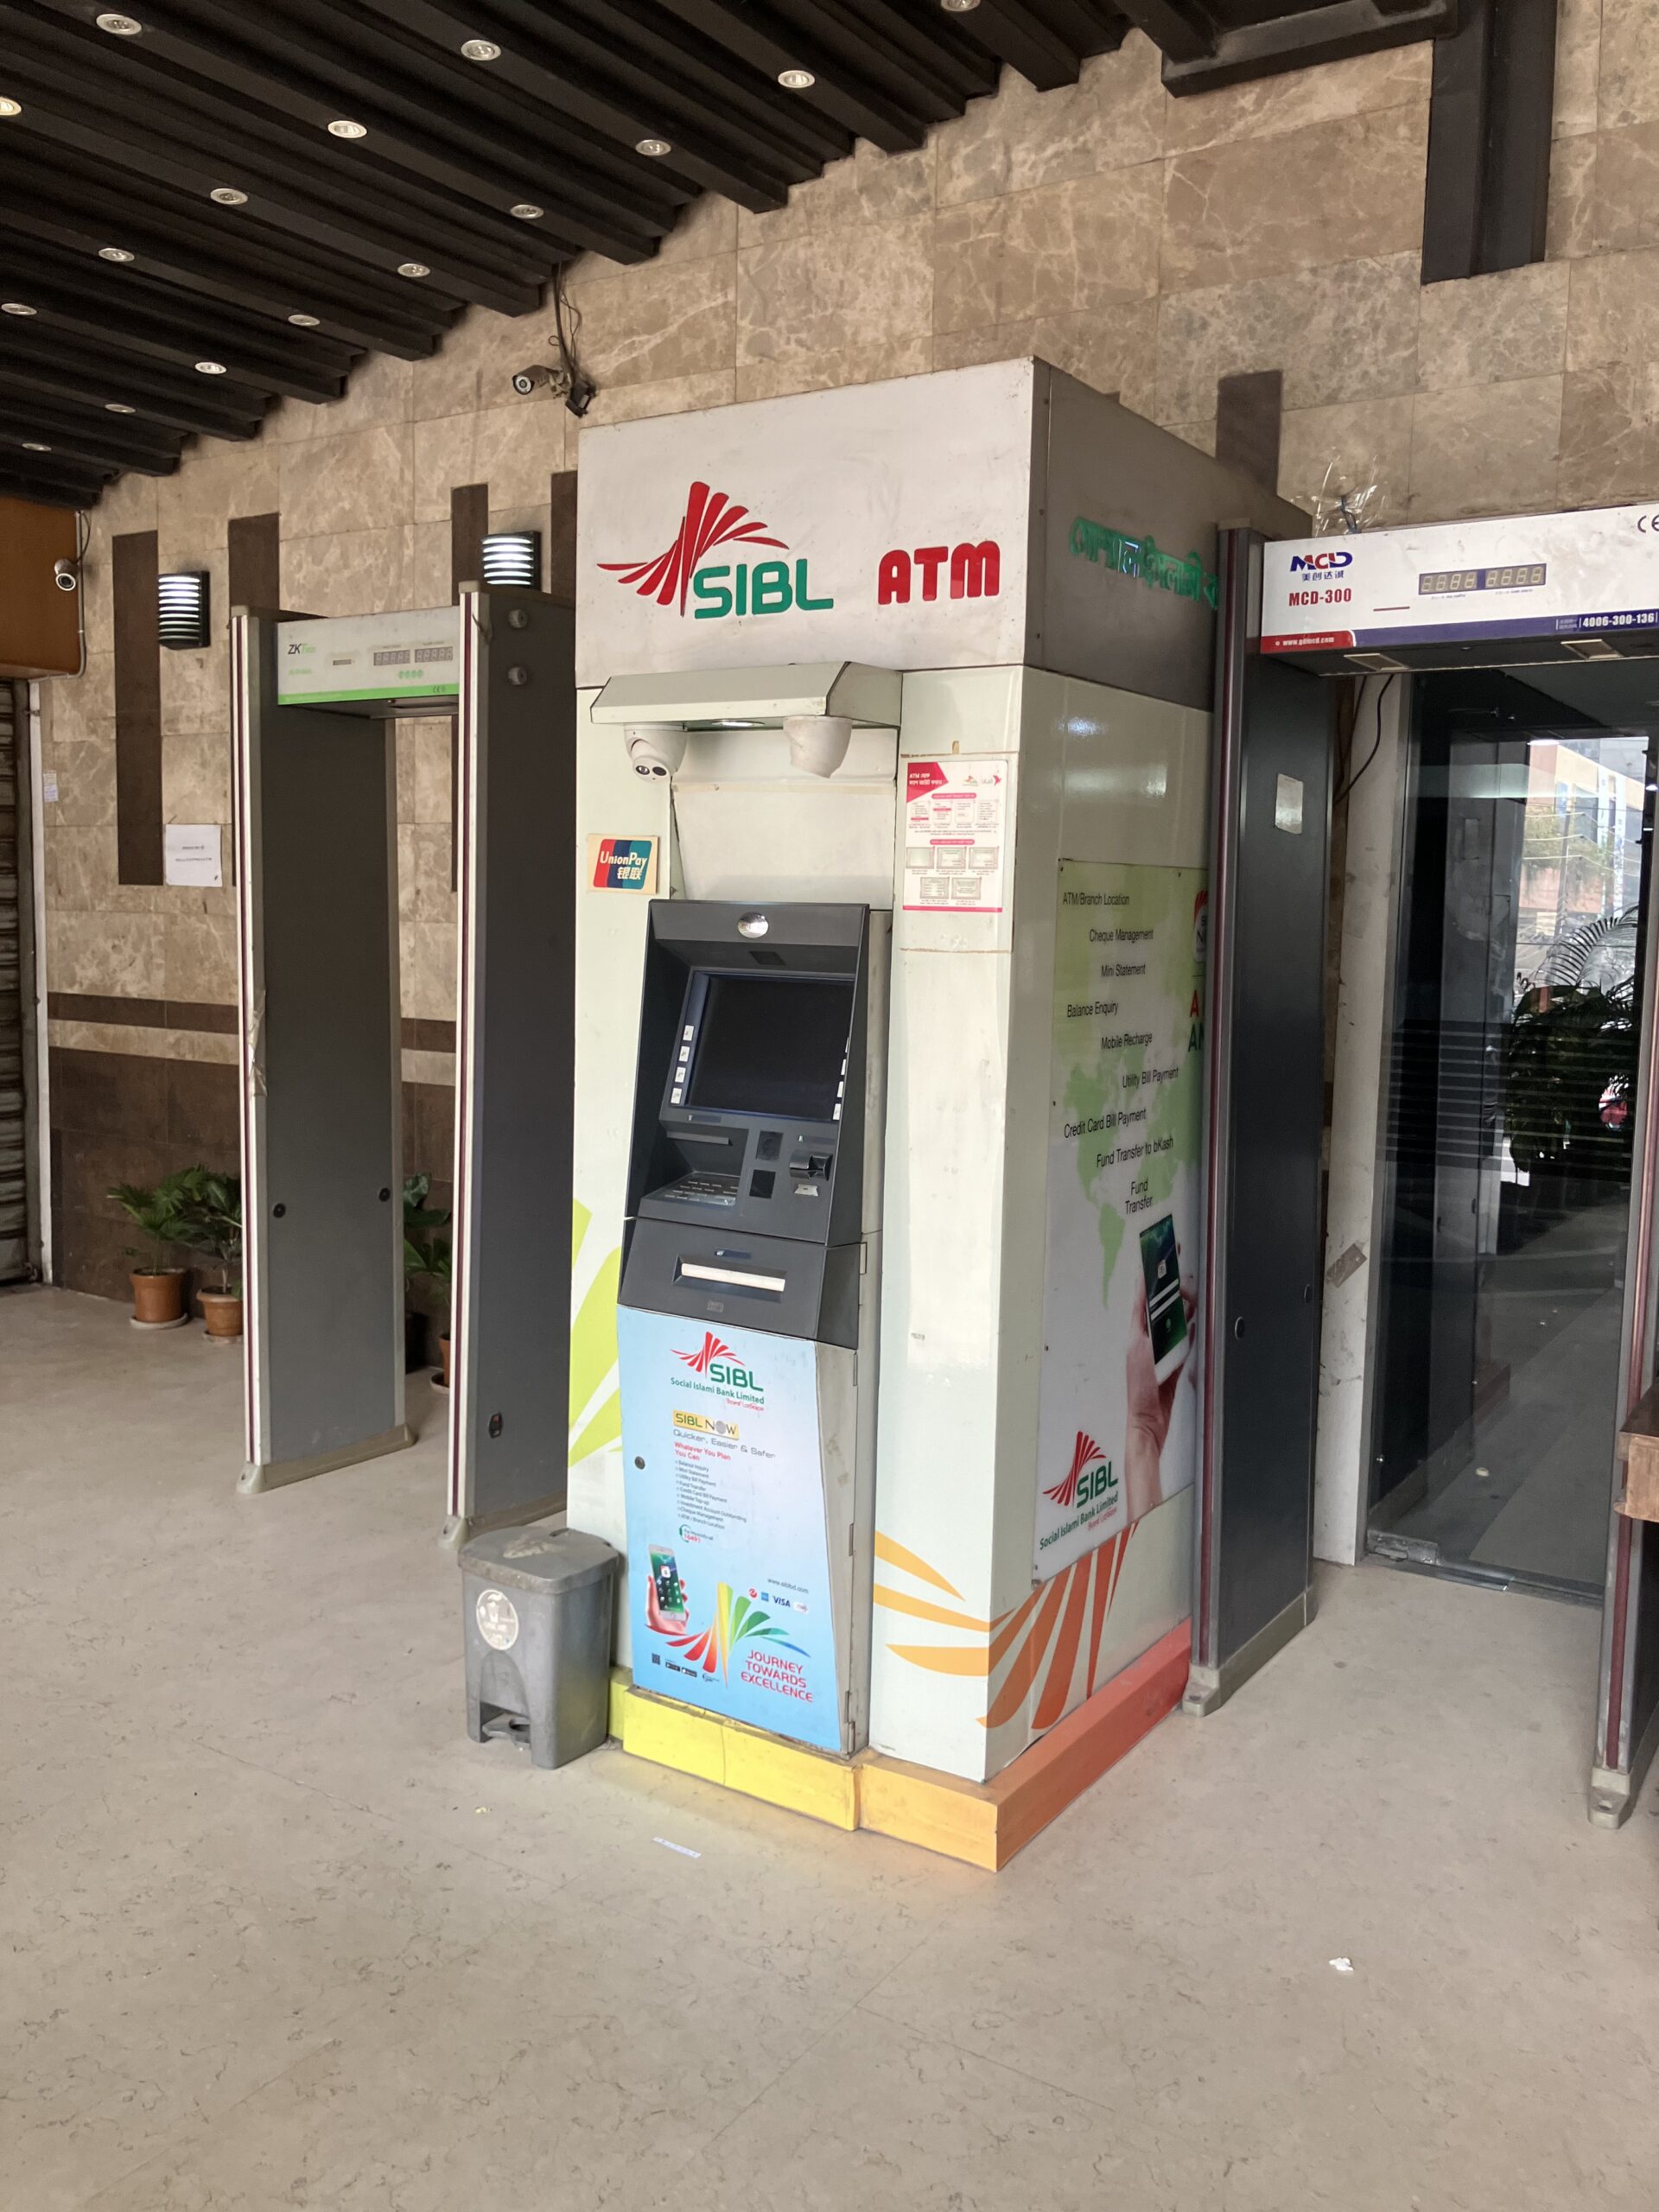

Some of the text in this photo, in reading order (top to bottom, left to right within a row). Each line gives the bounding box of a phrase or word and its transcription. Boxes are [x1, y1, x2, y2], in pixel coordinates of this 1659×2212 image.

[1290, 551, 1353, 572] MCD
[878, 540, 1001, 606] ATM
[694, 558, 835, 620] SIBL
[1288, 588, 1351, 607] MCD-300
[1582, 613, 1655, 628] 4006-300-136
[600, 850, 648, 871] UnionPay
[1063, 892, 1129, 906] ATM/Branch Location
[1090, 929, 1154, 944] Cheque Management
[1102, 963, 1146, 977] Mini Statement
[1067, 1001, 1118, 1018] Balance Enquiry
[1102, 1033, 1153, 1050] Mobile Recharge
[1122, 1067, 1179, 1089] Utility Bill Payment
[1064, 1109, 1147, 1139] Credit Card Bill Payment
[1096, 1135, 1173, 1168] Fund Transfer to bKash
[1130, 1177, 1148, 1196] Fund
[1125, 1195, 1154, 1215] Transfer
[709, 1363, 764, 1392] SIBL
[671, 1377, 765, 1404] Social Islami Bank Limited
[676, 1413, 702, 1428] SIBL
[673, 1428, 776, 1459] Quicker, Easier & Safer
[675, 1440, 731, 1460] Whatever You Plan
[675, 1448, 700, 1461] You Can
[1077, 1460, 1119, 1509] SIBL
[1039, 1526, 1060, 1550] Social
[1061, 1516, 1079, 1538] Islami
[1080, 1507, 1096, 1526] Bank
[1096, 1491, 1119, 1515] Limited
[772, 1595, 791, 1608] VISA
[747, 1649, 804, 1675] JOURNEY
[746, 1660, 807, 1688] TOWARDS
[741, 1671, 814, 1702] EXCELLENCE
